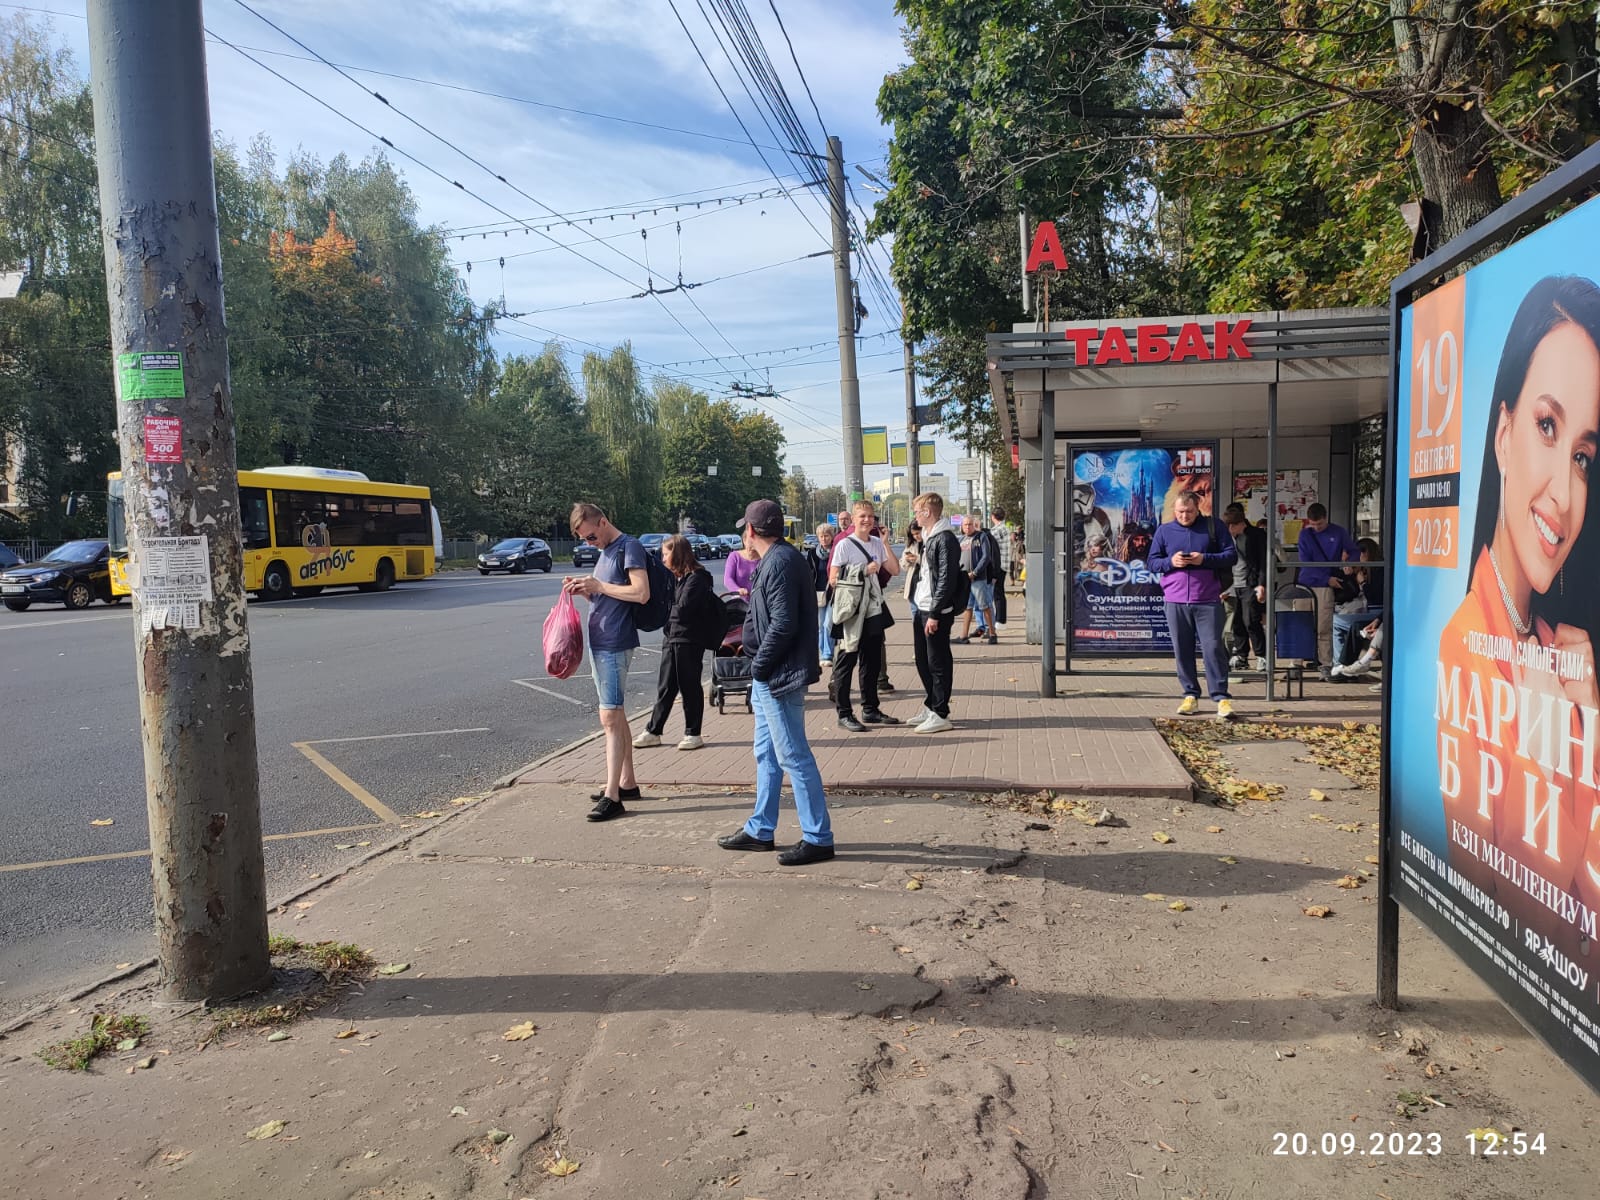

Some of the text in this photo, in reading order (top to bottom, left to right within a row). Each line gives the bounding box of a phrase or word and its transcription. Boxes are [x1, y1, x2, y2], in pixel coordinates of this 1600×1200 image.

[1025, 221, 1069, 272] А
[1065, 319, 1254, 366] ТАБАК
[1416, 330, 1459, 439] 19
[152, 444, 174, 453] 500
[1177, 449, 1211, 467] 1.11
[1414, 443, 1455, 474] СЕНТЯБРЯ
[1416, 481, 1451, 499] НАЧАЛО 19:00
[1413, 518, 1452, 557] 2023
[300, 549, 356, 580] автобус
[1086, 594, 1147, 605] Саундтрек
[1468, 630, 1585, 682] ПОЕЗДАМИ, САМОЛЁТАМИ
[1434, 660, 1600, 792] МАРИН
[1400, 829, 1412, 852] ВСЕ
[1412, 838, 1436, 873] БИЛЕТЫ
[1437, 858, 1447, 880] НА
[1447, 865, 1510, 930] МАРИНАБРИЗ.РФ
[1451, 819, 1479, 862] КЗЦ
[1481, 839, 1599, 942] МИЛЛЕНИУМ
